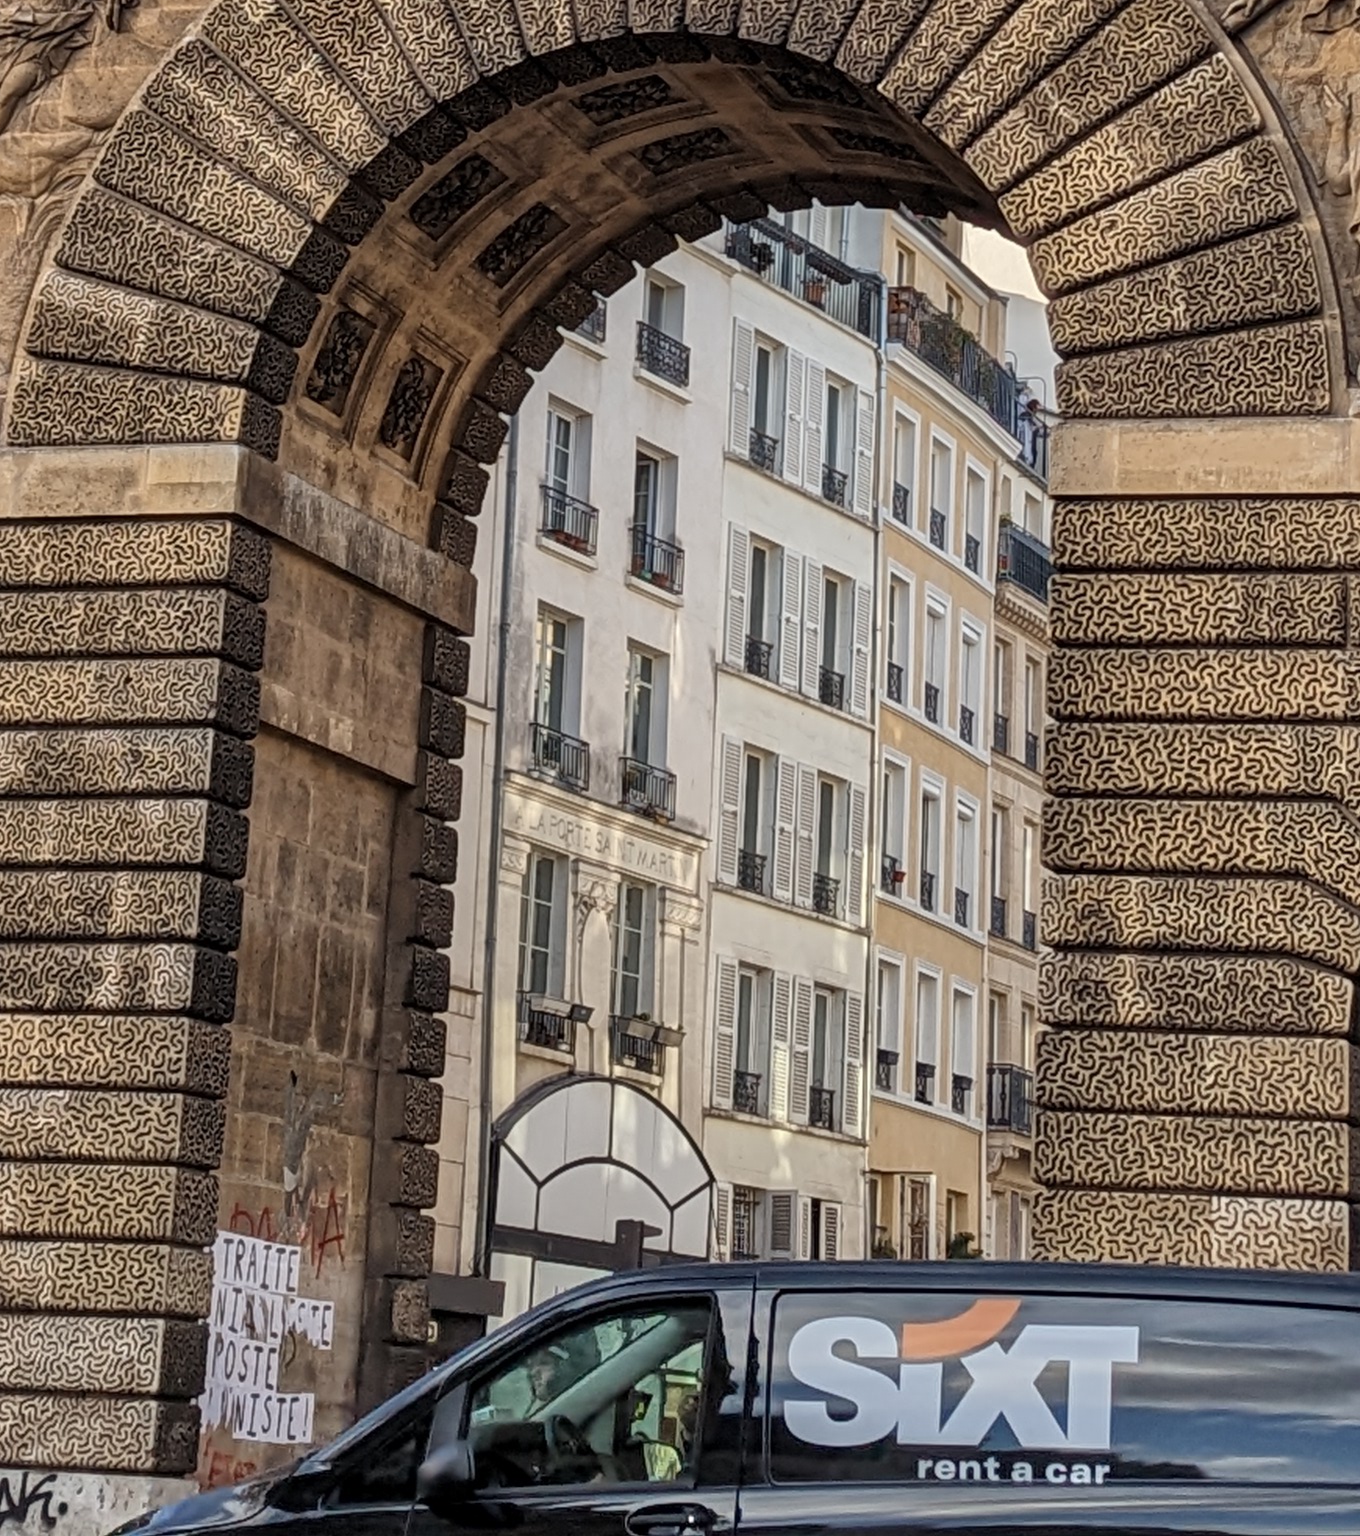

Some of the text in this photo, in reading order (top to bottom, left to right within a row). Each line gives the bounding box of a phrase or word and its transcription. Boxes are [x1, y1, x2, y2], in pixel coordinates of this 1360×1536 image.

[917, 1456, 1111, 1485] rent a car
